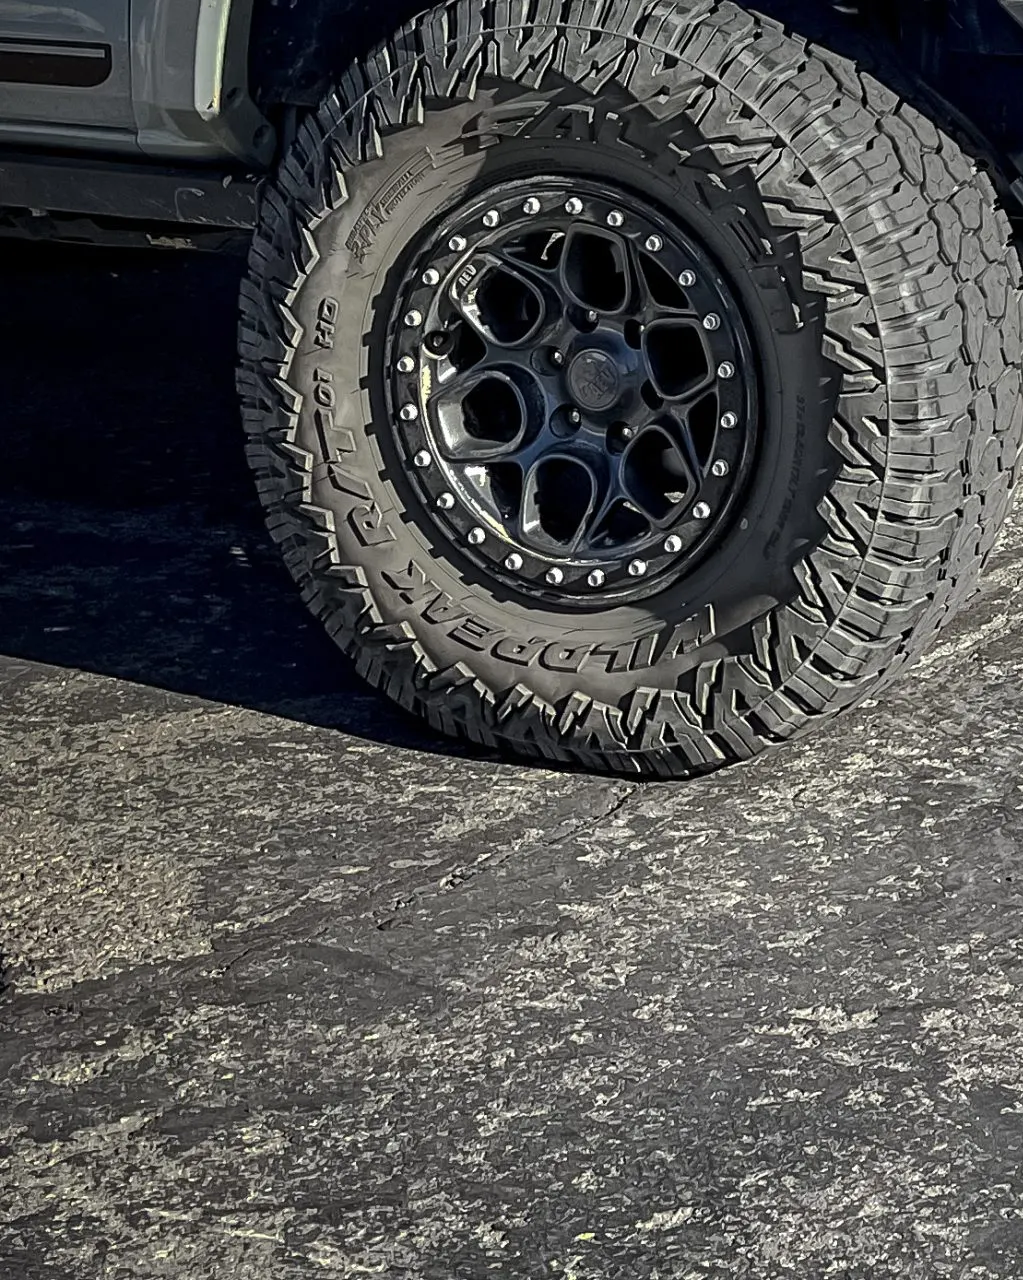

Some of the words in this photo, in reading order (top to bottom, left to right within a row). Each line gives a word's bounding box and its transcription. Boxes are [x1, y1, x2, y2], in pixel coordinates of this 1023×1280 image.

[458, 264, 477, 287] AEV
[314, 296, 339, 349] HD
[380, 559, 716, 673] WILDPEAK
